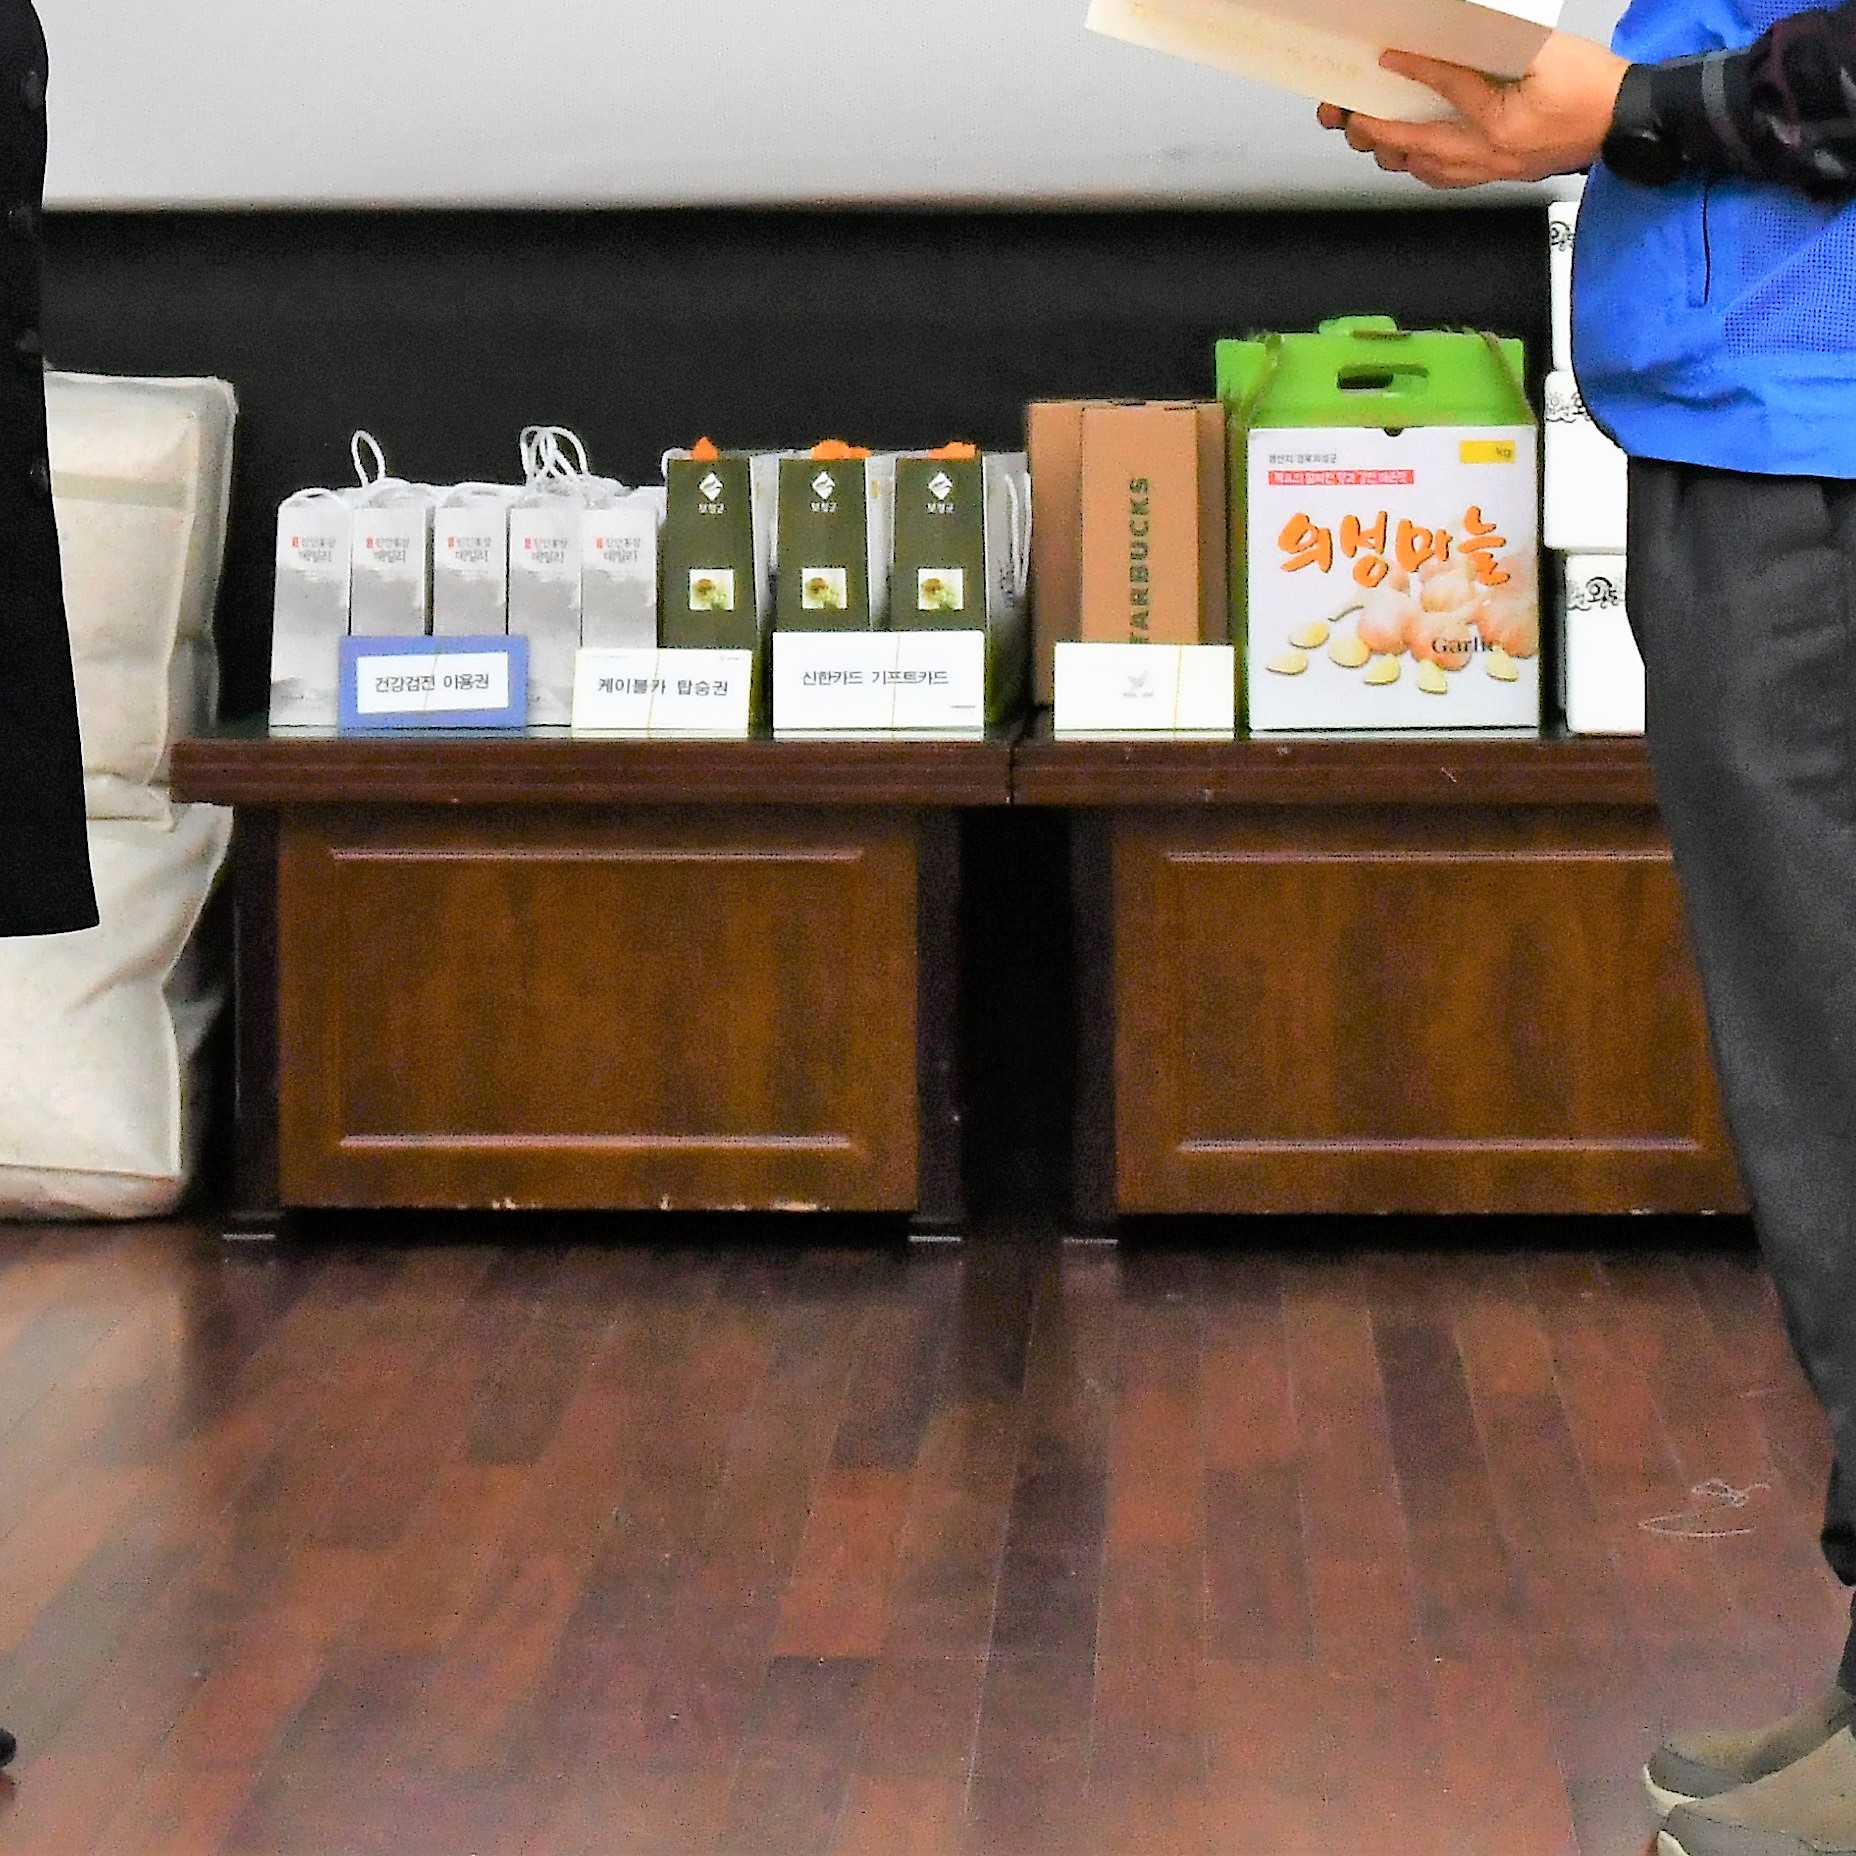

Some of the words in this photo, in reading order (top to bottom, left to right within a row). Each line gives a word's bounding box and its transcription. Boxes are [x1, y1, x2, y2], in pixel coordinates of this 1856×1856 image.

[1496, 447, 1512, 461] kg
[1277, 505, 1510, 588] 의성마늘
[1129, 478, 1149, 644] TARBUCKS
[375, 675, 435, 693] 건강검진
[443, 672, 489, 691] 이용권
[802, 670, 863, 686] 신한카드
[872, 670, 949, 685] 기프트카드
[677, 680, 728, 697] 탑승권
